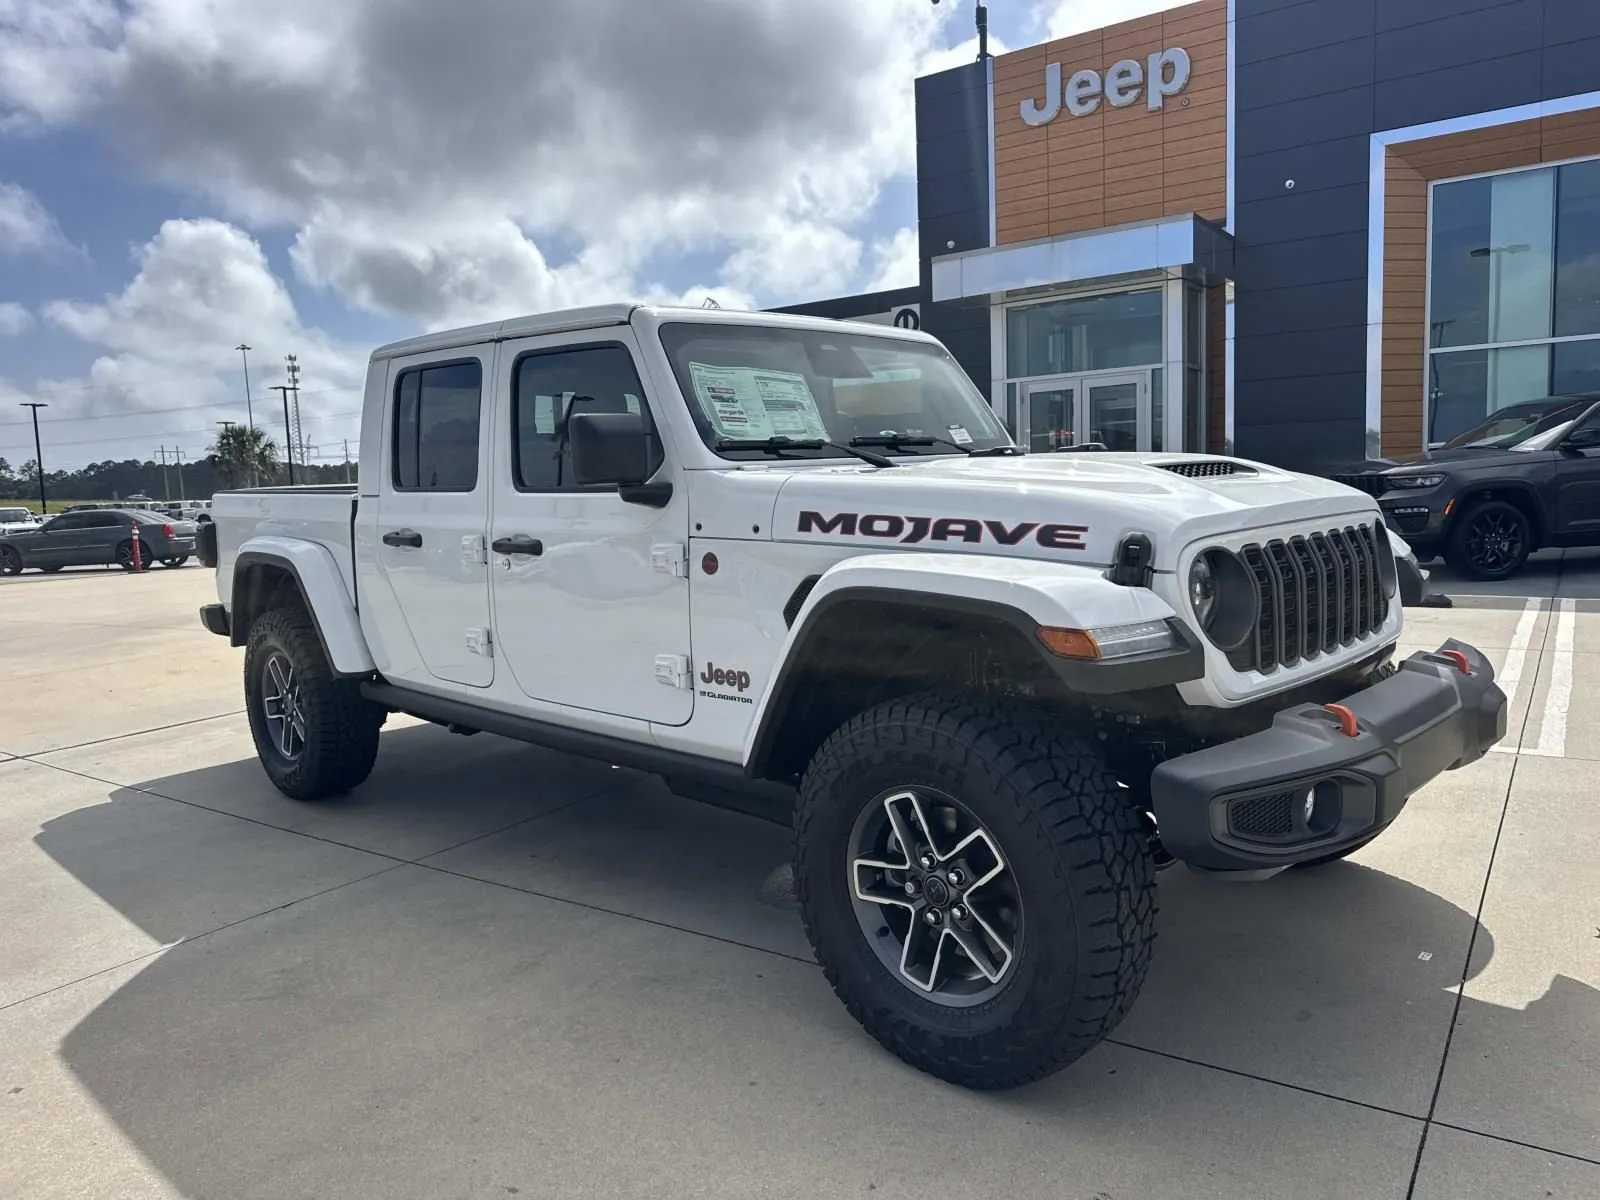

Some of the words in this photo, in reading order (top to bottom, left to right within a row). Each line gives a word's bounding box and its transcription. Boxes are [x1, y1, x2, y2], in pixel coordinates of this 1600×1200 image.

[1020, 47, 1191, 126] Jeep
[797, 510, 1089, 550] MOJAVE
[700, 661, 751, 692] Jeep
[707, 691, 753, 704] GLADIATOR
